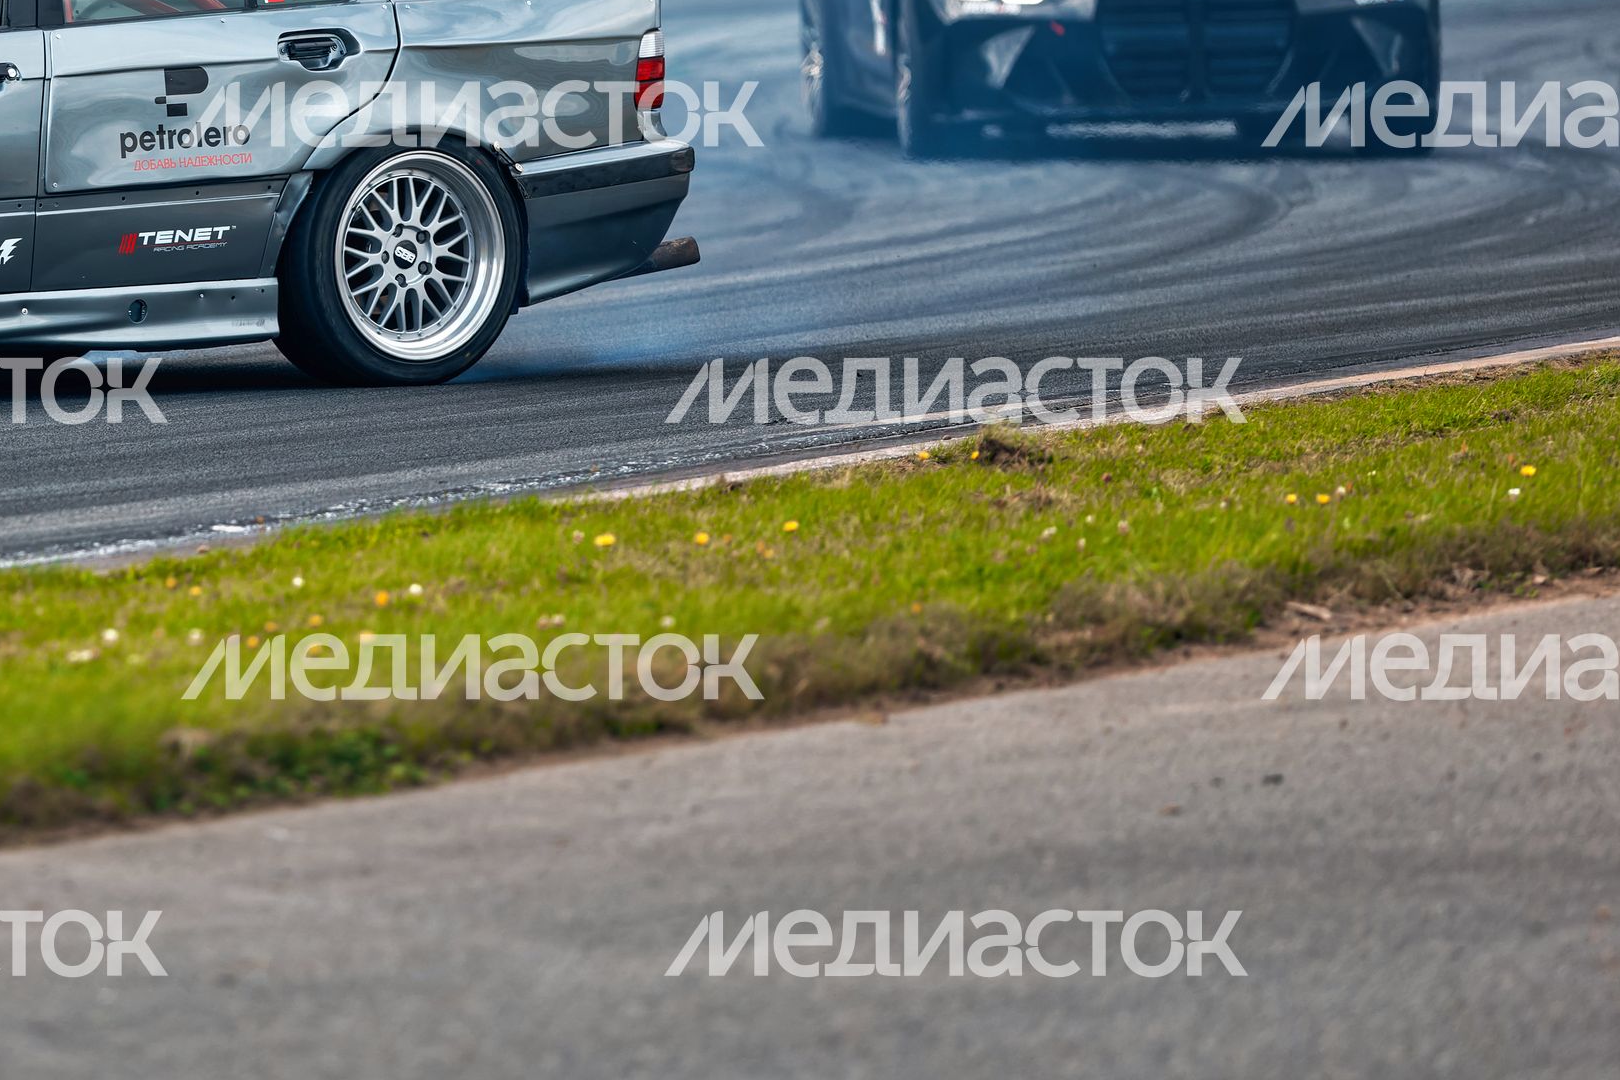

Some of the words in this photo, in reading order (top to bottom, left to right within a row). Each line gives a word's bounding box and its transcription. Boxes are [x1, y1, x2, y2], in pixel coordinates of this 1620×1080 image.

[119, 122, 251, 158] petrolero
[134, 158, 177, 171] ДОБАВЬ
[179, 153, 253, 168] НАДЕЖНОСТИ
[138, 225, 231, 245] TENET
